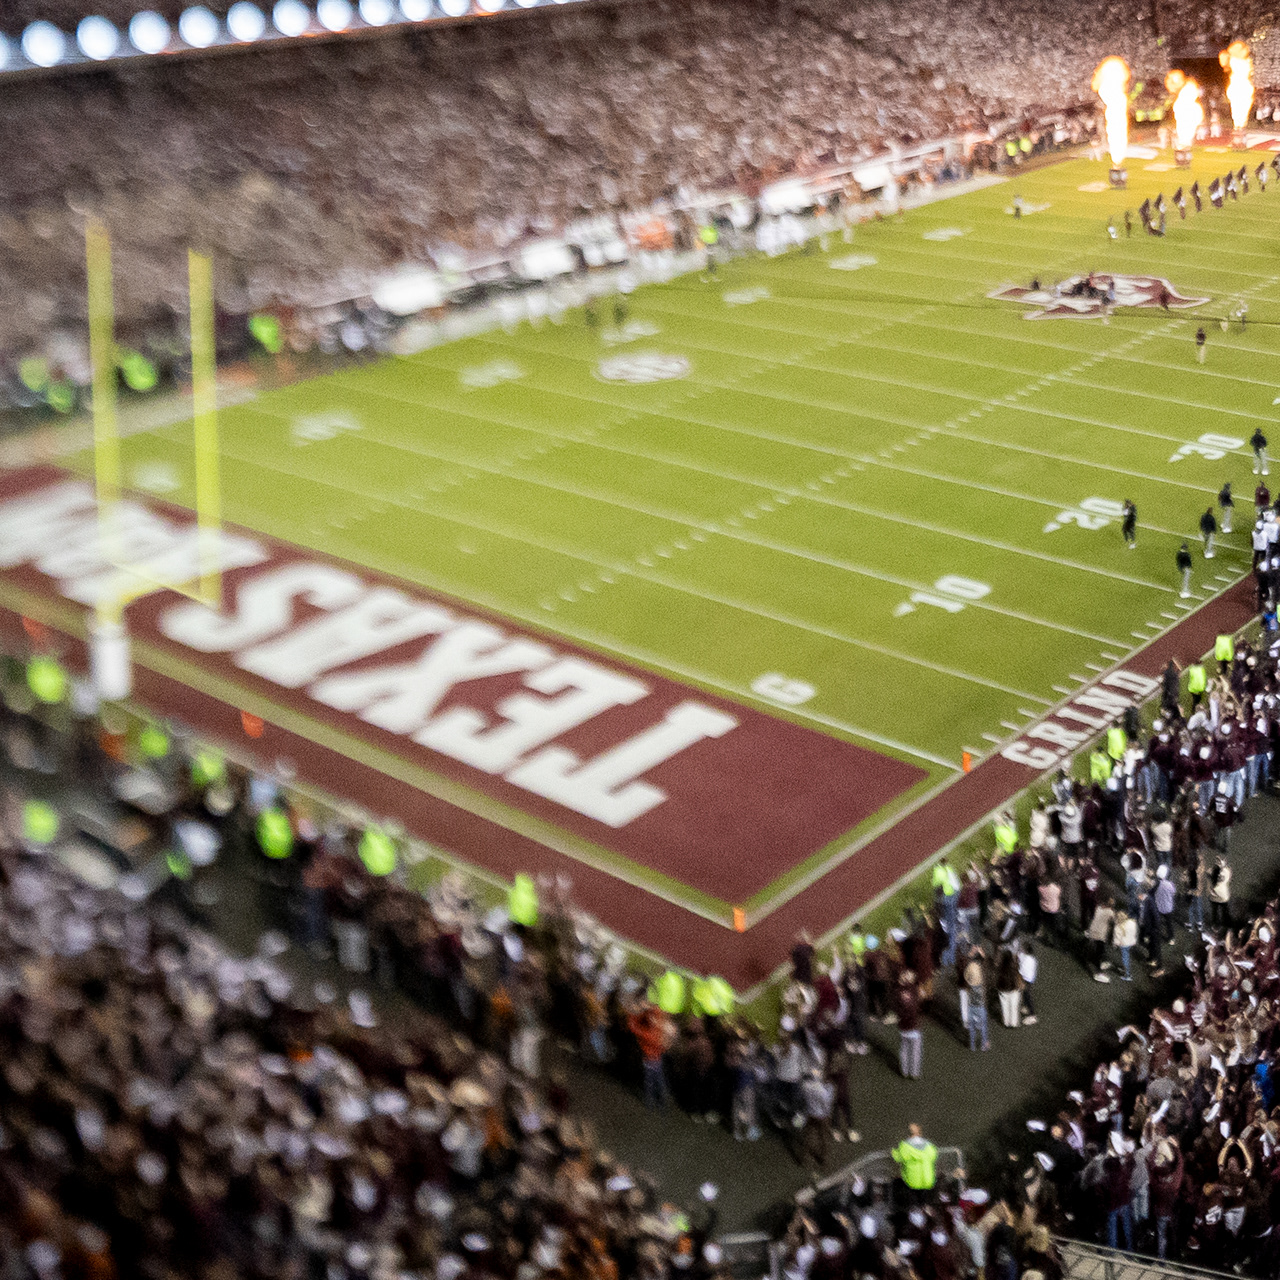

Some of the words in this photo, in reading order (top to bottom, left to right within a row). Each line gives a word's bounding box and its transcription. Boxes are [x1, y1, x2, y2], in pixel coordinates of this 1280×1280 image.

[1177, 433, 1245, 460] 30
[1056, 496, 1124, 530] 20
[911, 574, 992, 614] 10
[158, 563, 740, 829] TEXAS
